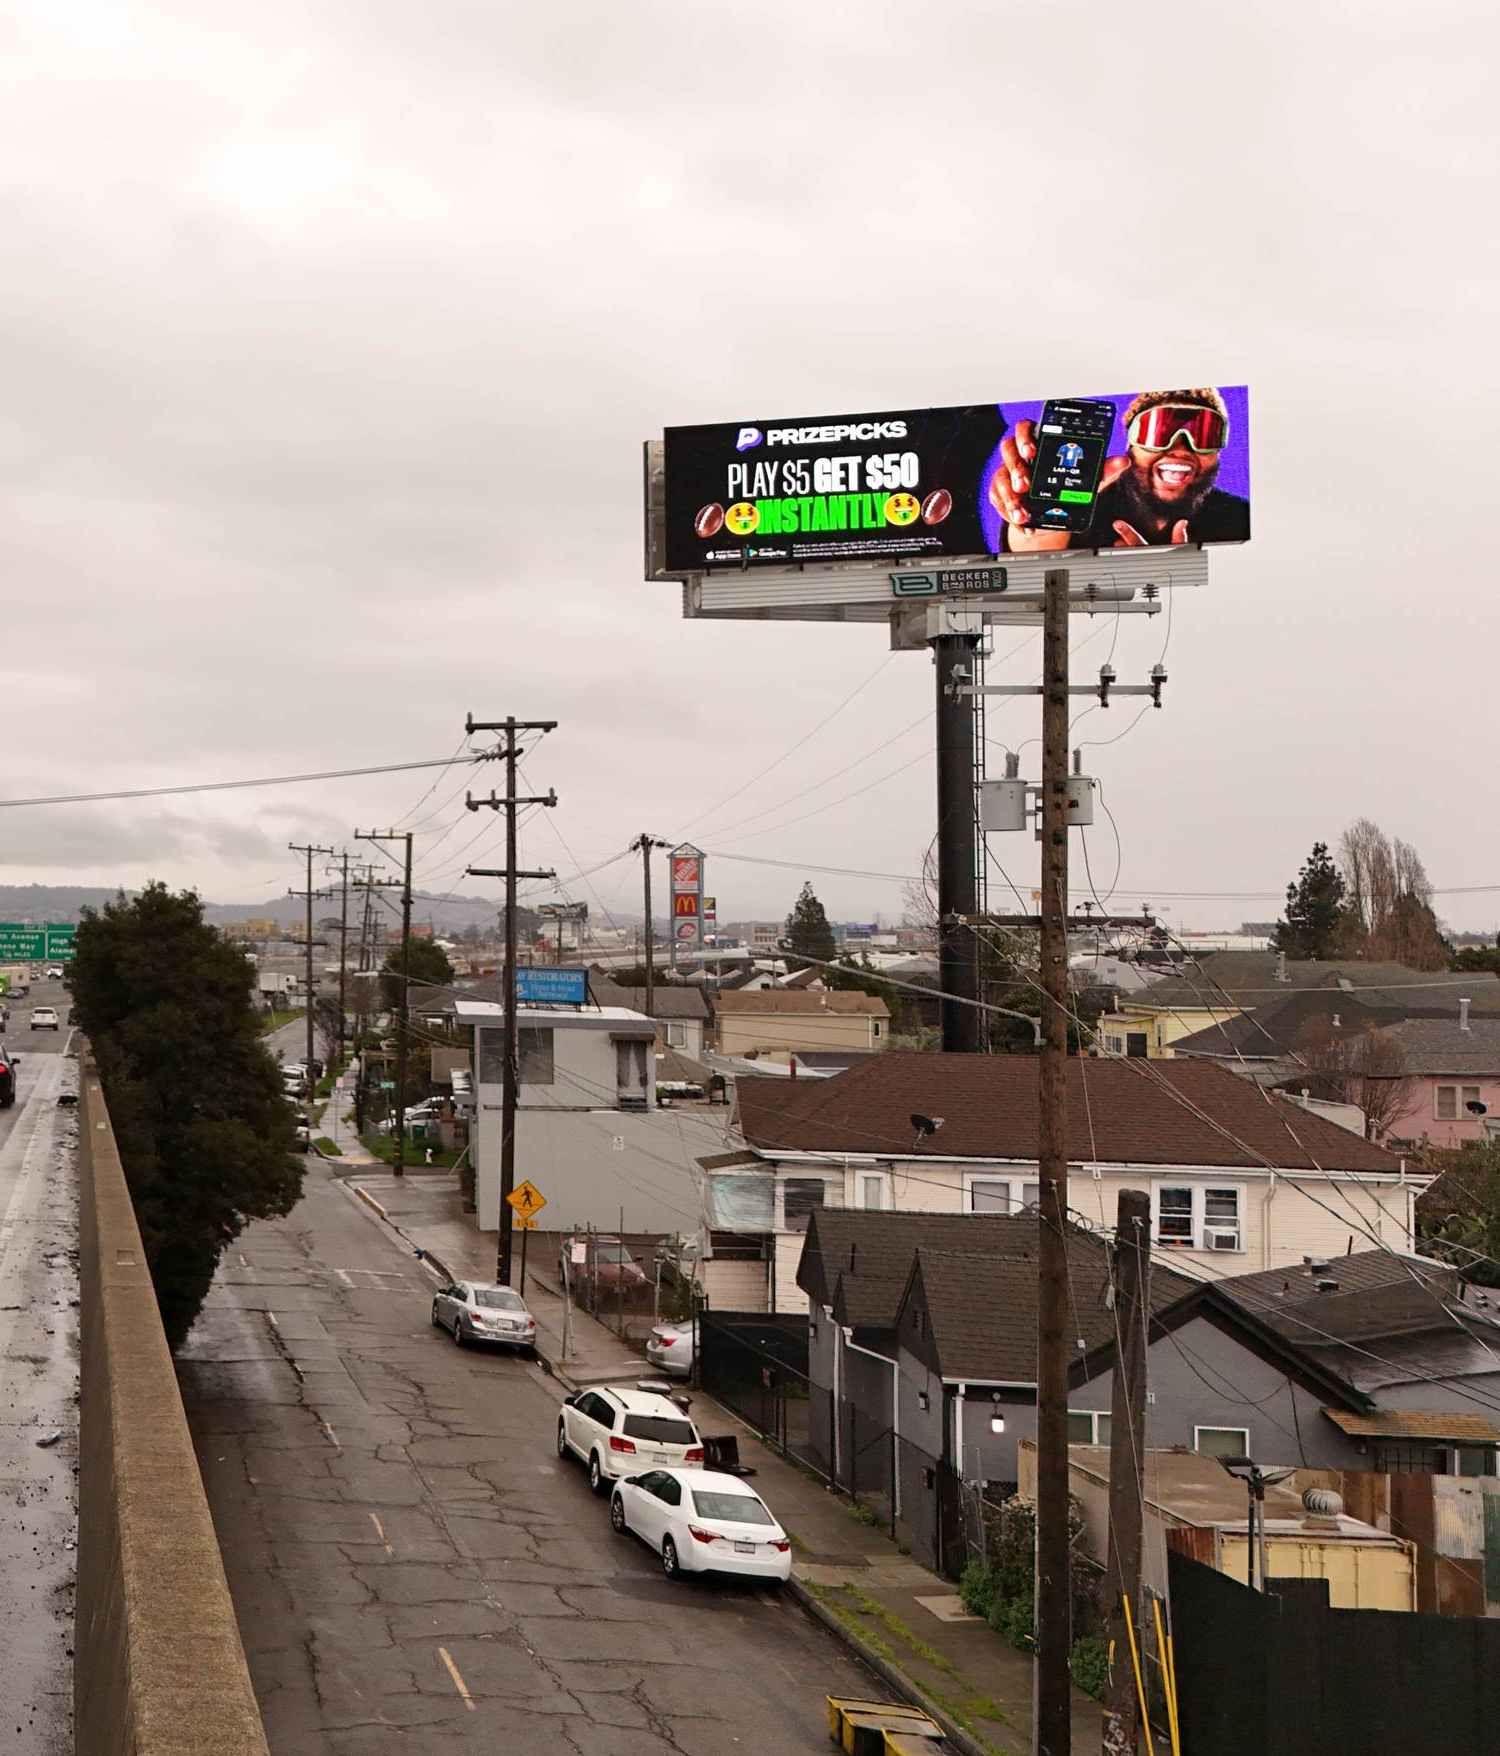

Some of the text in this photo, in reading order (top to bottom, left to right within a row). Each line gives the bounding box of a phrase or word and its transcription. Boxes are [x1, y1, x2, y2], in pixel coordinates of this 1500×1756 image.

[767, 421, 908, 446] PRIZEPICKS
[728, 452, 919, 498] PLAY $5 GET $50
[755, 492, 890, 534] INSTANTLY
[942, 571, 989, 581] BECKER
[942, 580, 990, 590] BARDS
